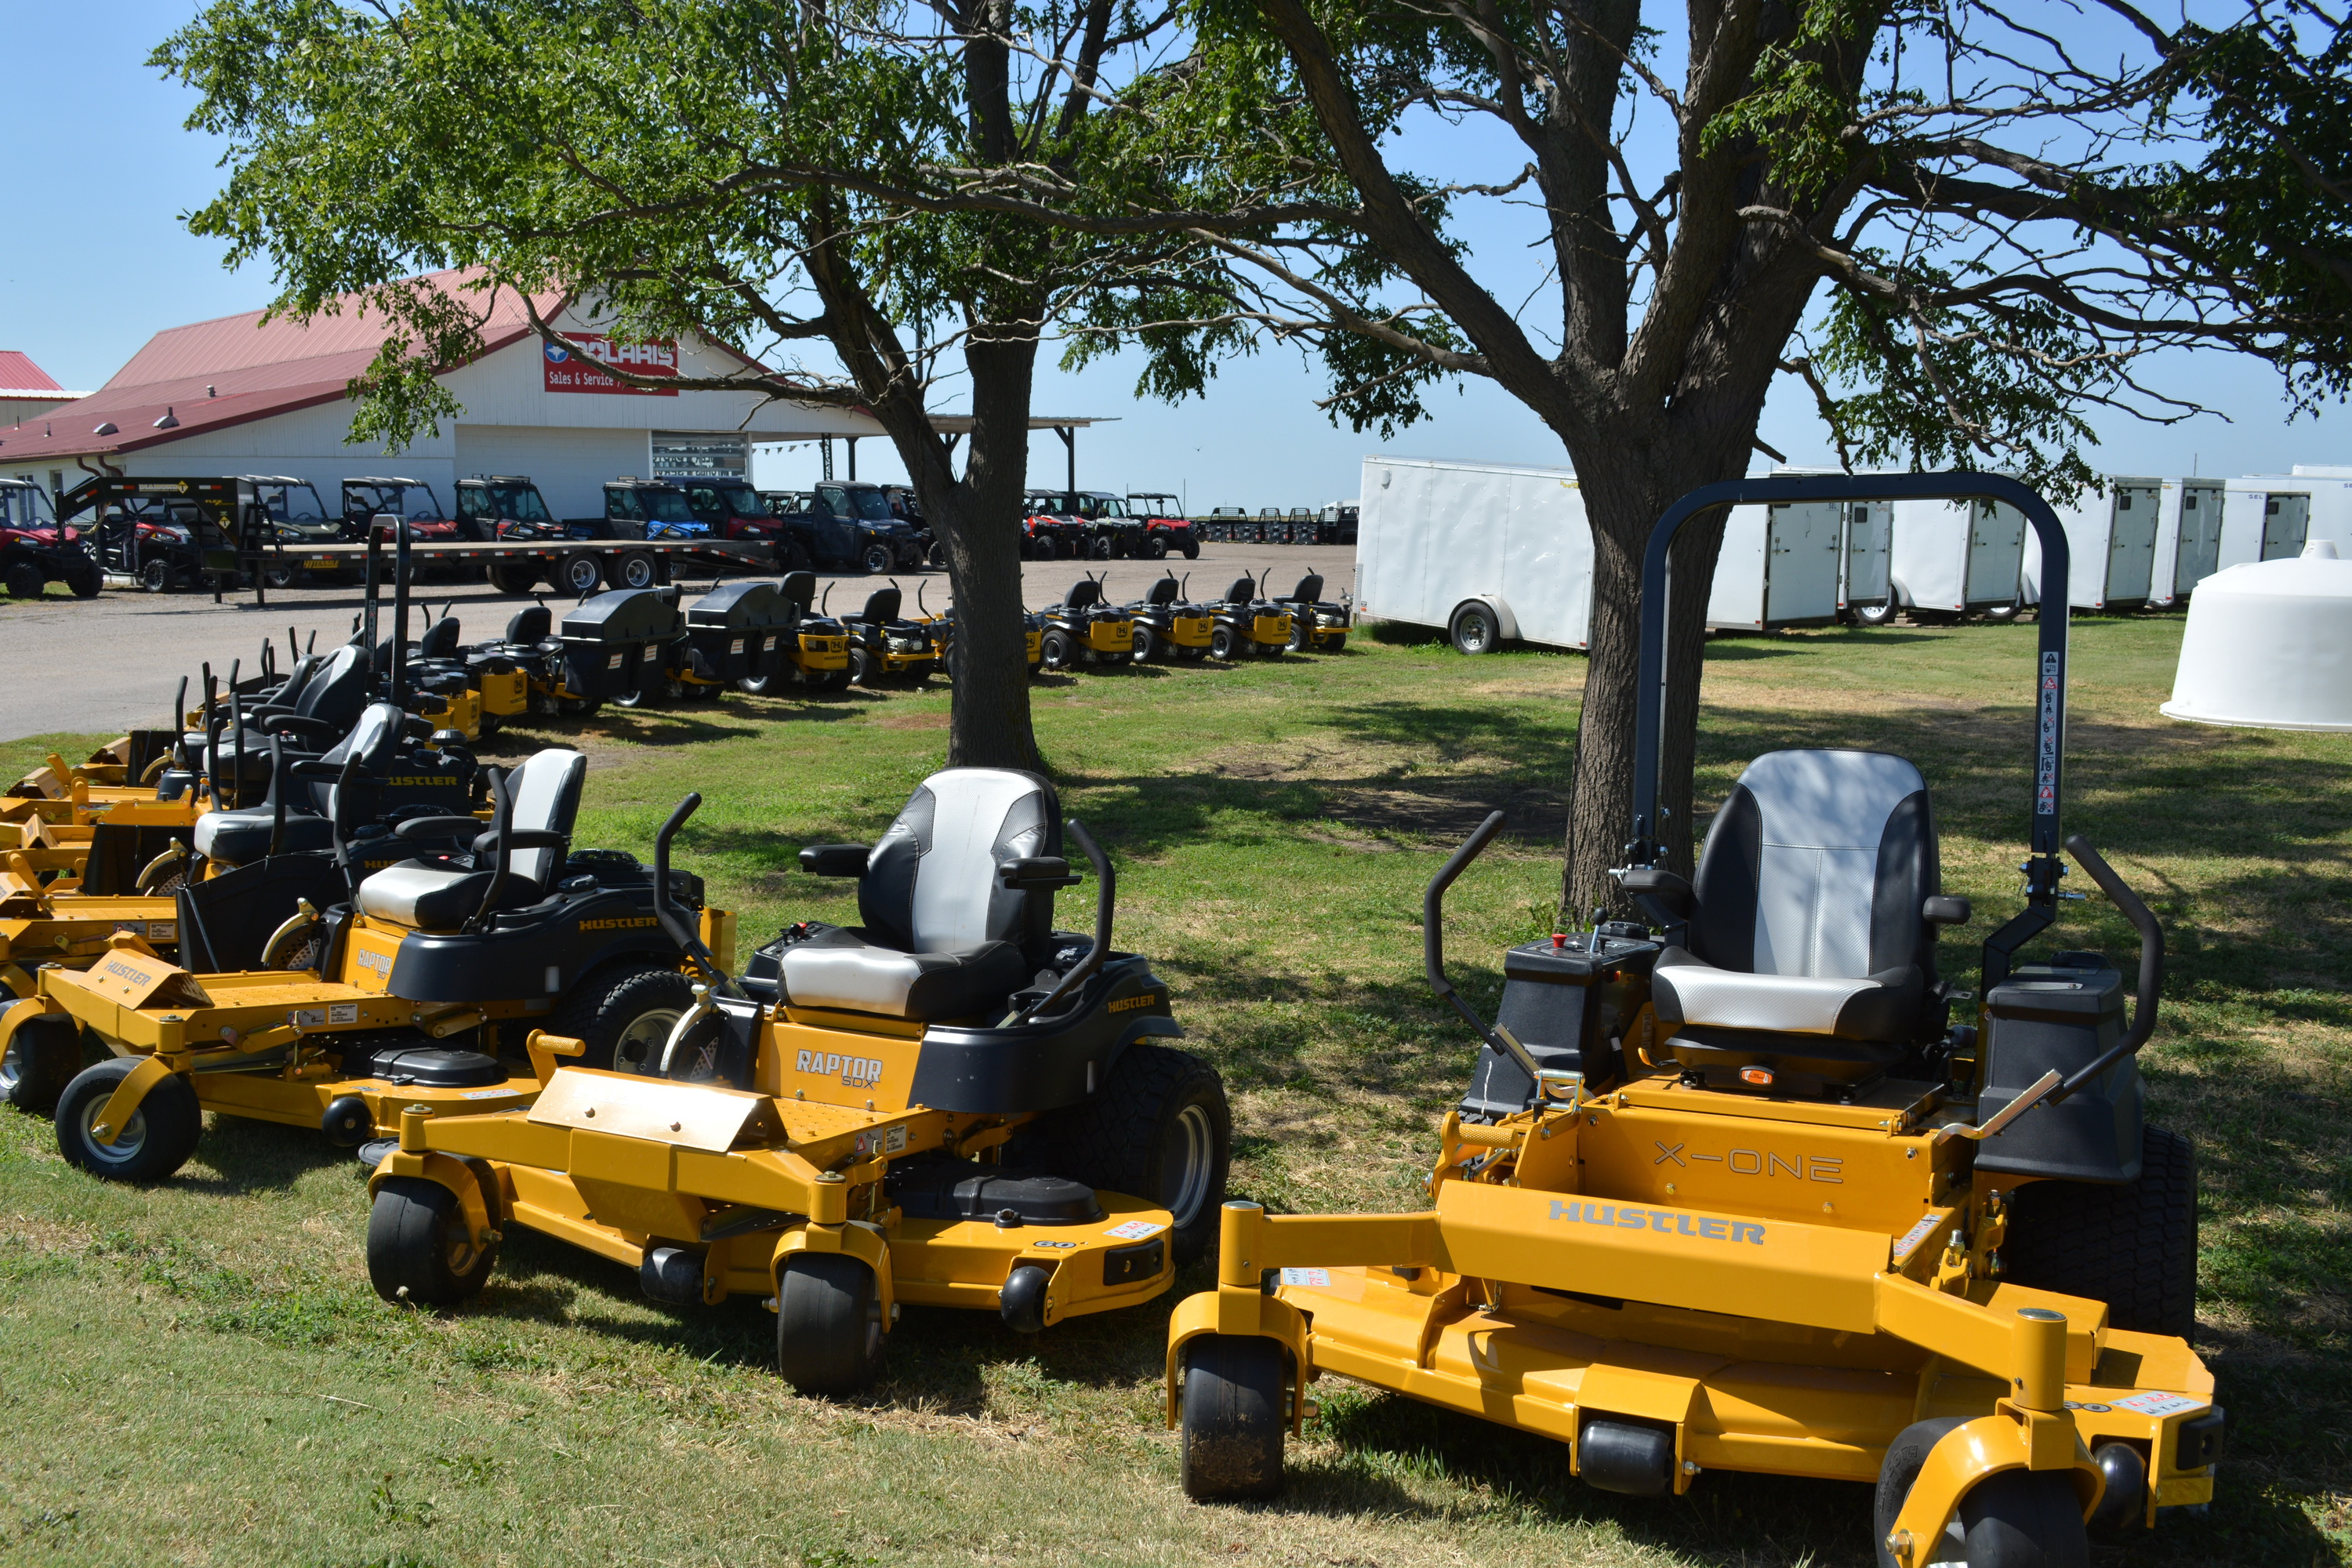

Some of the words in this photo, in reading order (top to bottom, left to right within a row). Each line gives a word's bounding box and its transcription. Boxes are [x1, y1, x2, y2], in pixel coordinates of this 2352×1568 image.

[550, 372, 572, 384] Sales
[575, 372, 581, 385] &
[583, 372, 614, 386] Service
[387, 776, 458, 786] USTLER
[579, 916, 658, 931] HUSTLER
[357, 948, 392, 975] RAPTOR
[103, 960, 152, 986] HUSTLER
[1107, 994, 1155, 1014] HUSTLER
[795, 1049, 883, 1083] RAPTOR
[841, 1076, 876, 1091] SDX
[1654, 1140, 1844, 1185] X-ONE
[1548, 1200, 1766, 1246] HUSTLER
[1033, 1240, 1076, 1249] 60
